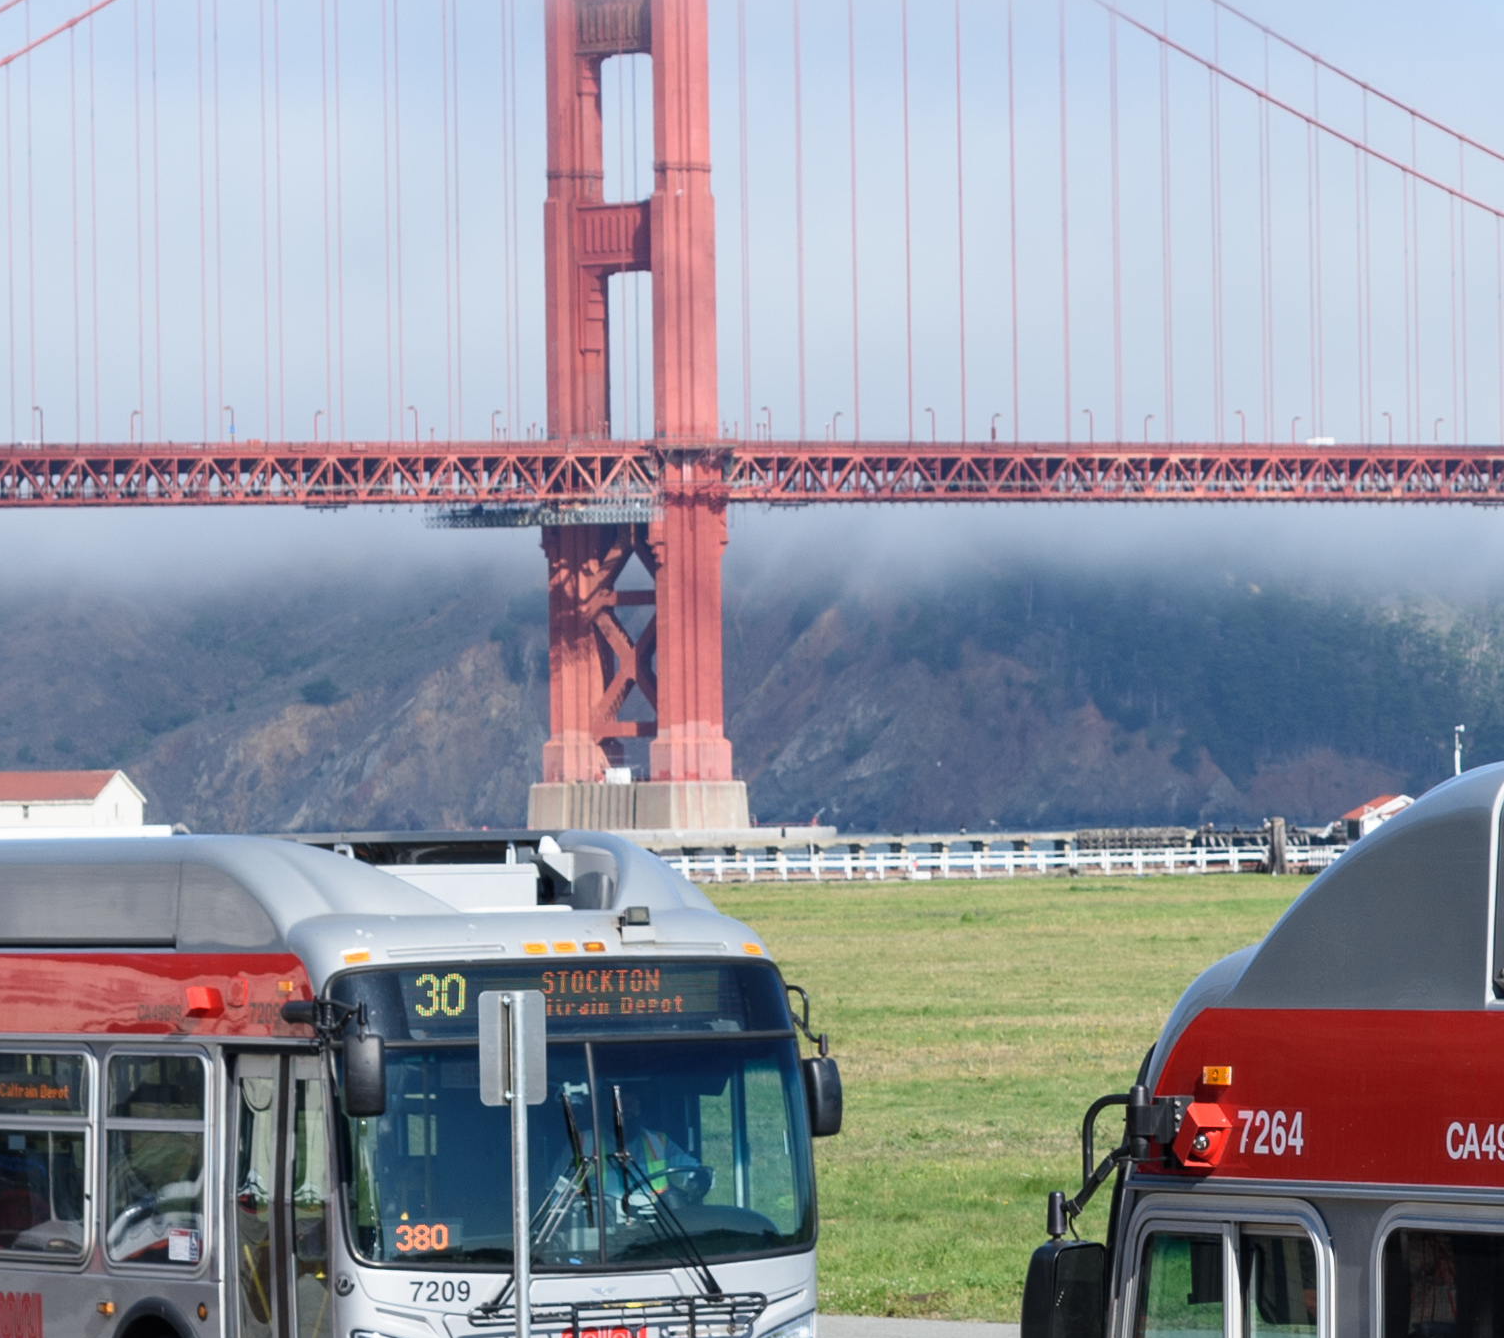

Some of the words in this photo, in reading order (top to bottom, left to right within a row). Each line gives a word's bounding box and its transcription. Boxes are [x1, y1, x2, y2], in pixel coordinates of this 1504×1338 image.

[541, 968, 661, 994] STOCKTON
[415, 973, 466, 1017] 30
[620, 995, 684, 1015] Depot
[248, 1002, 281, 1025] 7209
[1237, 1109, 1304, 1157] 7264
[396, 1223, 449, 1252] 380
[409, 1280, 471, 1302] 7209
